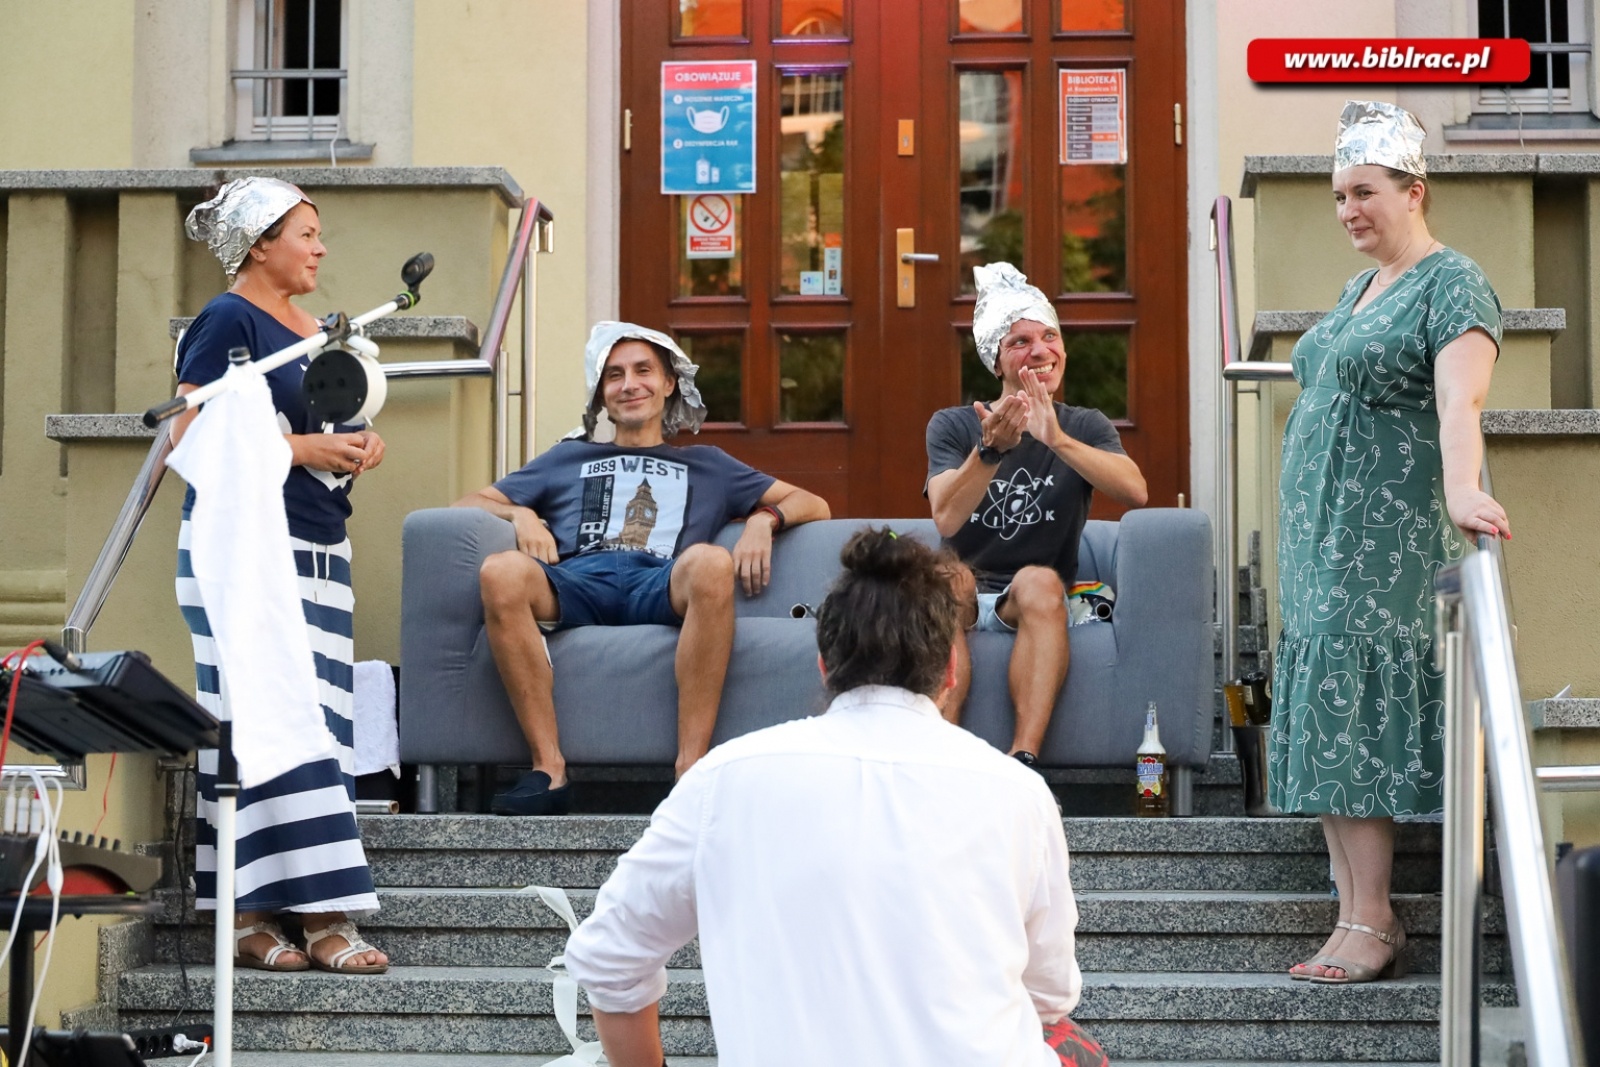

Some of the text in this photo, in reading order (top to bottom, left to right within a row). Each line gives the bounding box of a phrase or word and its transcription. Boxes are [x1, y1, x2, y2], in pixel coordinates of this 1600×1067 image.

[674, 71, 742, 83] OBOWIĄZUJE
[1067, 75, 1118, 84] BIBLIOTEKA
[587, 456, 685, 480] 1859 WEST
[996, 475, 1054, 494] YZYK
